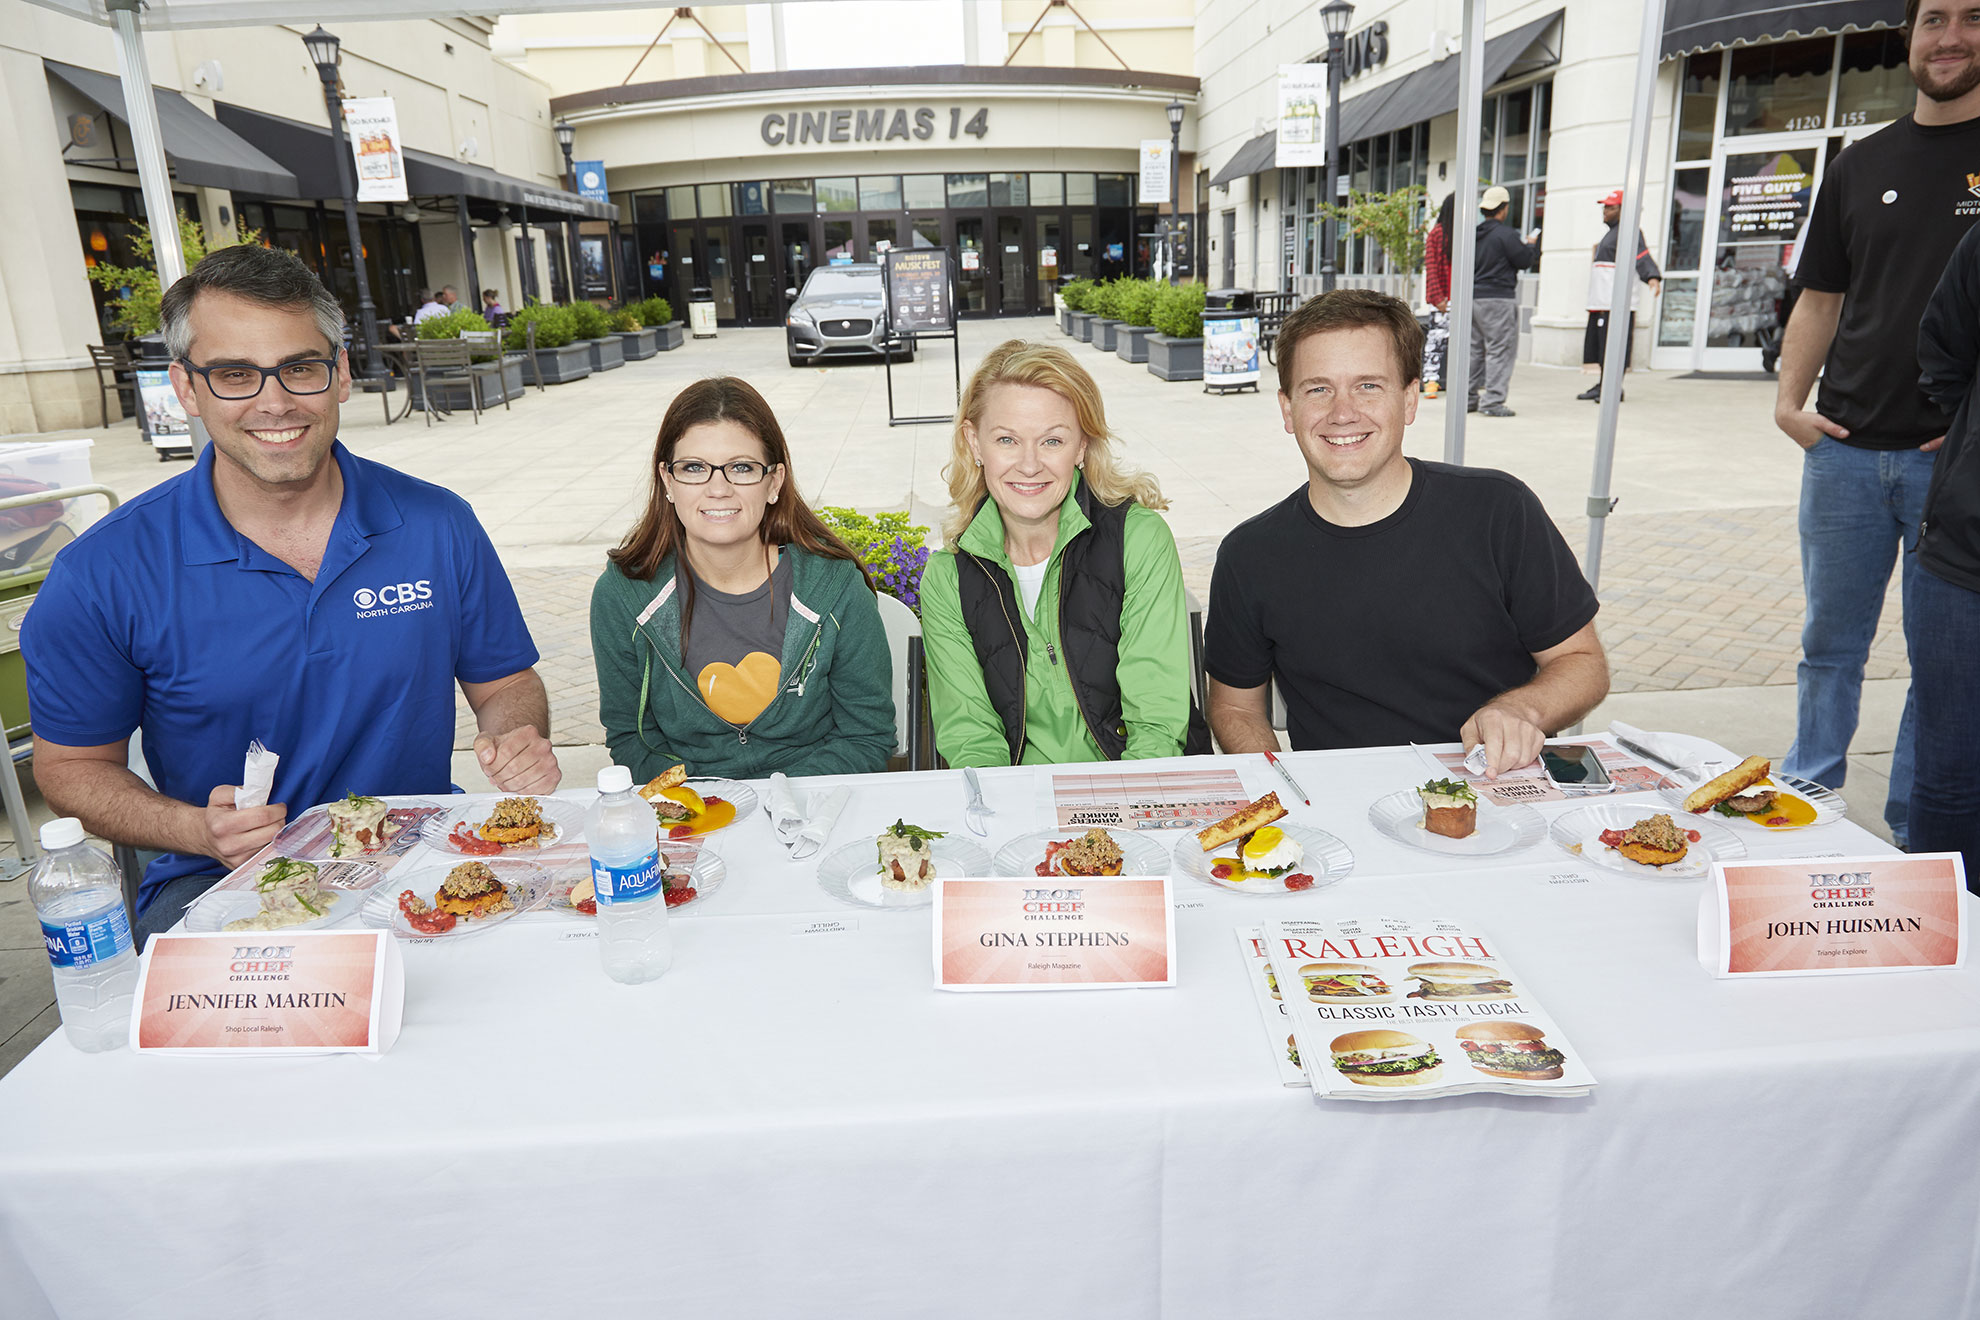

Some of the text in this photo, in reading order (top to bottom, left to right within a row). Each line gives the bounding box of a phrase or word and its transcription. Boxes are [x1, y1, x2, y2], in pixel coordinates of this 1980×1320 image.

[1343, 20, 1389, 83] UYS
[760, 106, 989, 146] CINEMAS 14
[1785, 111, 1866, 130] 4120 155
[1732, 181, 1802, 196] FIVE GUYS
[1733, 211, 1795, 223] OPEN 7 DAYS
[894, 260, 941, 271] MUSIC FEST
[379, 580, 432, 605] CBS
[356, 601, 434, 619] NORTH CAROLINA
[1492, 784, 1538, 793] MARKET
[1129, 800, 1237, 810] CHALLENGE
[1067, 817, 1123, 826] FARMERS'
[1808, 871, 1872, 888] IRON
[1023, 888, 1085, 901] IRON
[1811, 887, 1876, 900] CHEF
[1023, 902, 1086, 913] CHEF
[1813, 900, 1875, 909] CHALLENGE
[1766, 916, 1922, 940] JOHN HUISMAN
[979, 931, 1130, 948] GINA STEPHENS
[231, 945, 295, 960] IRON
[1280, 935, 1495, 959] RALEIGH
[1817, 948, 1868, 957] Triangle Explorer
[229, 961, 294, 973] CHEF
[1027, 962, 1082, 971] Raleigh Magazine
[229, 974, 290, 982] CHALLENGE
[167, 992, 347, 1012] JENNIFER MARTIN
[1317, 1003, 1529, 1020] CLASSIC TASTY LOCAL
[225, 1025, 242, 1033] Shop
[260, 1025, 284, 1034] Raleigh
